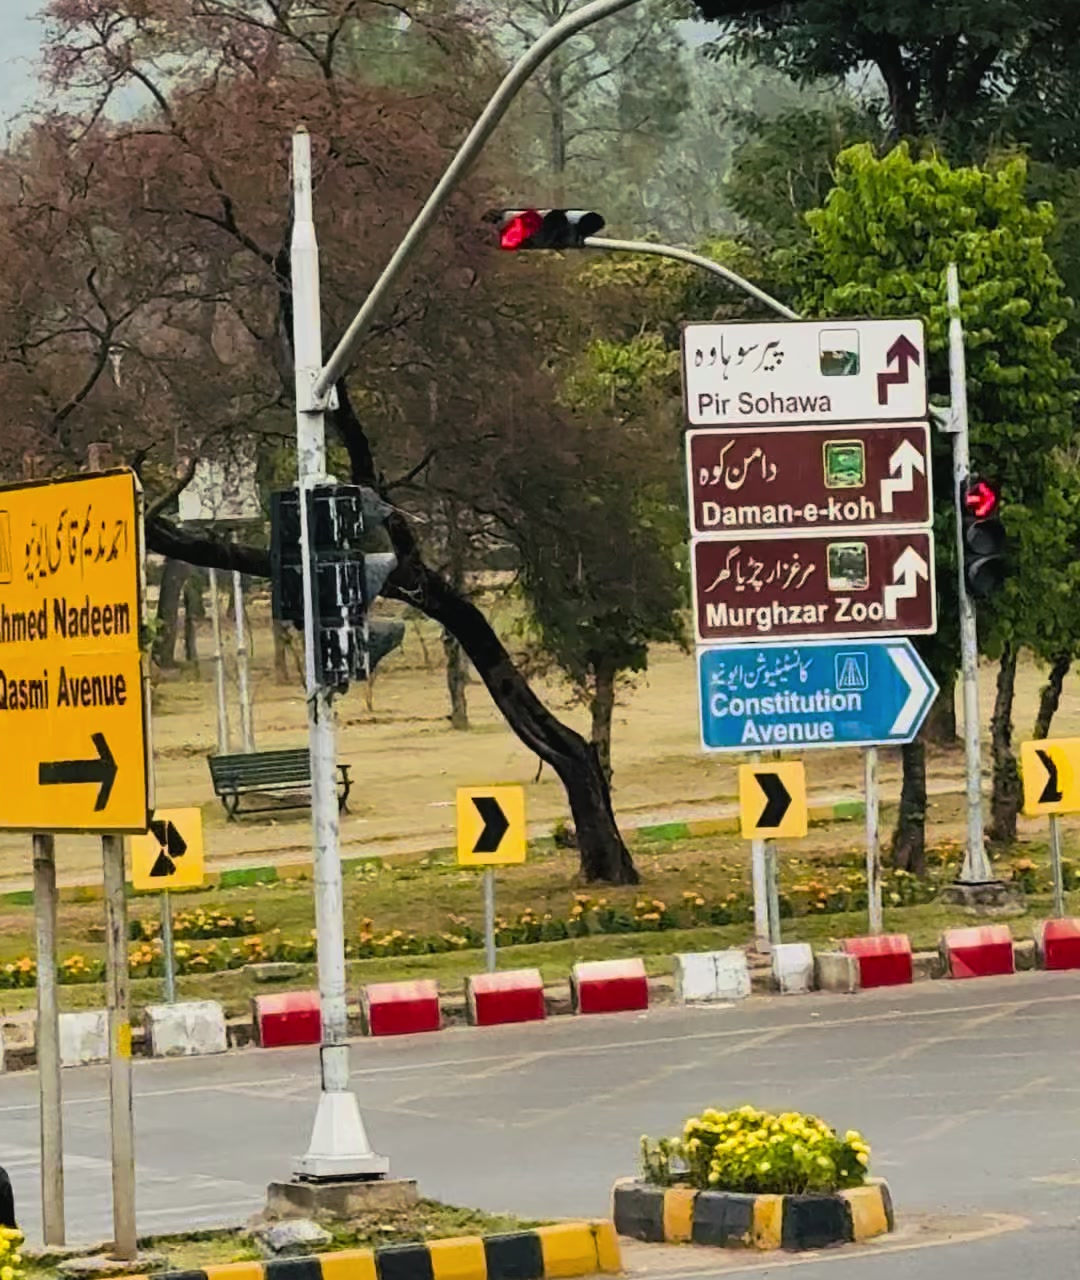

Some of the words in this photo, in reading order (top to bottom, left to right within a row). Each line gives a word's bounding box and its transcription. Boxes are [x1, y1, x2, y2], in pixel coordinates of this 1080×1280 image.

[751, 339, 785, 373] پیر
[697, 392, 731, 416] Pir
[737, 391, 833, 415] Sohawa
[699, 439, 736, 486] کوہ
[724, 447, 778, 491] دامن
[701, 494, 877, 526] Daman-e-koh
[703, 545, 742, 593] گھر
[765, 552, 817, 591] مرغزار
[53, 594, 130, 639] Nadeem
[705, 600, 829, 632] Murghzar
[834, 597, 884, 622] Zoo
[56, 665, 127, 708] Avenue
[710, 688, 862, 718] Constitution
[740, 718, 835, 744] Avenue
